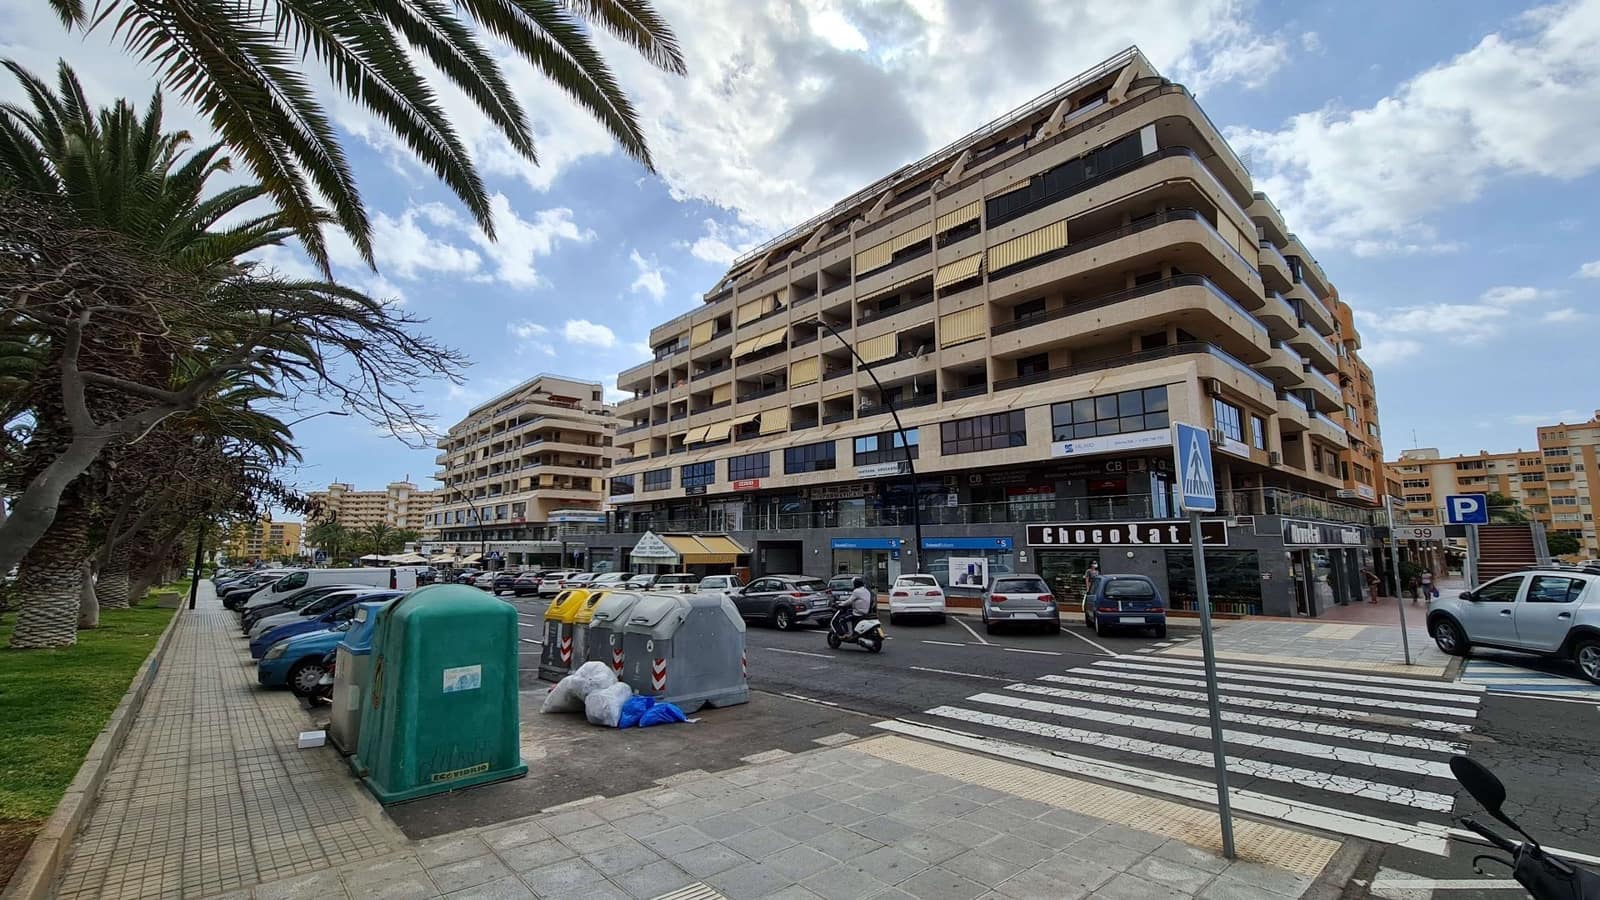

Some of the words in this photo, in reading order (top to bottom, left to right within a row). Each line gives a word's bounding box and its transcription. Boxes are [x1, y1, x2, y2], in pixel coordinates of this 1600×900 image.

[1105, 461, 1123, 472] CB
[969, 474, 983, 484] CB
[1453, 498, 1479, 521] P
[1413, 528, 1433, 538] 99
